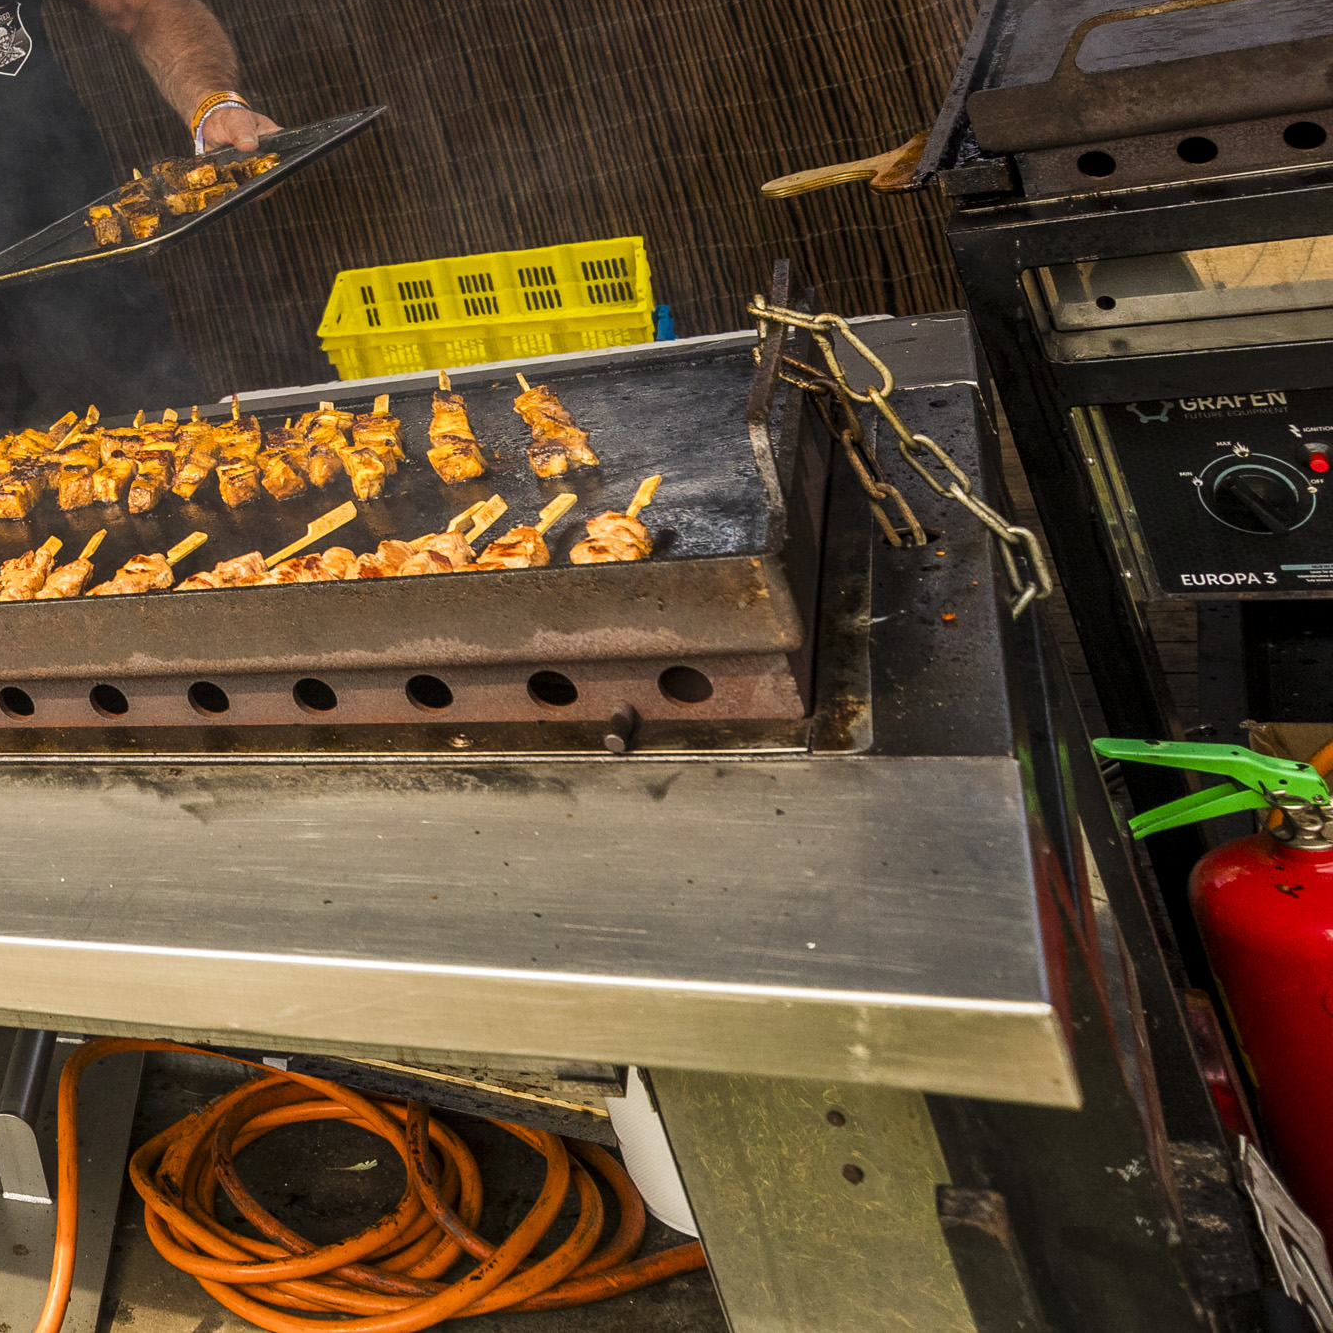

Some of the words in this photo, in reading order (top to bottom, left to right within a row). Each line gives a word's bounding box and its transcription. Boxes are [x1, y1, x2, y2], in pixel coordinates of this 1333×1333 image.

[1226, 406, 1289, 418] EQUIPMENT
[1180, 572, 1262, 586] EUROPA
[1263, 571, 1278, 584] 3
